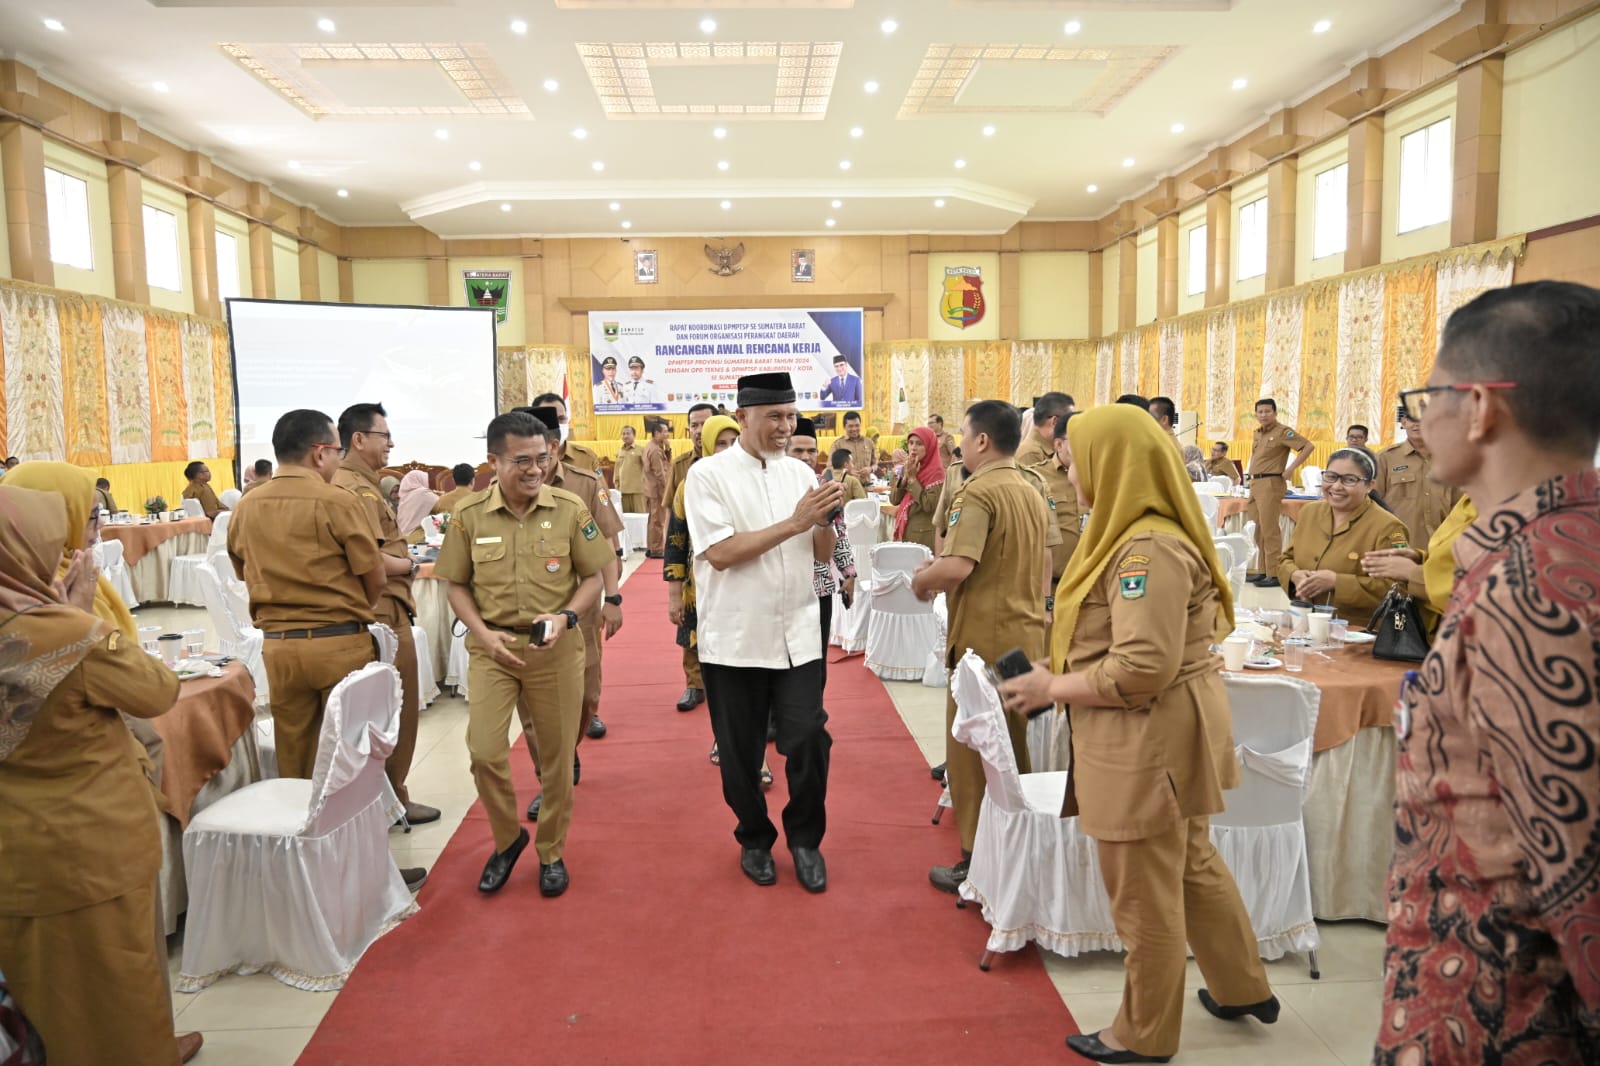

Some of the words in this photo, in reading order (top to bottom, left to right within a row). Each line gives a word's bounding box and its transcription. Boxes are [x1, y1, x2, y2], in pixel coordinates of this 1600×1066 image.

[670, 324, 688, 332] RAPAT
[655, 344, 714, 356] RANCANGAN
[716, 344, 744, 355] AWAL
[746, 343, 790, 354] RENCANA
[792, 342, 822, 354] KERJA
